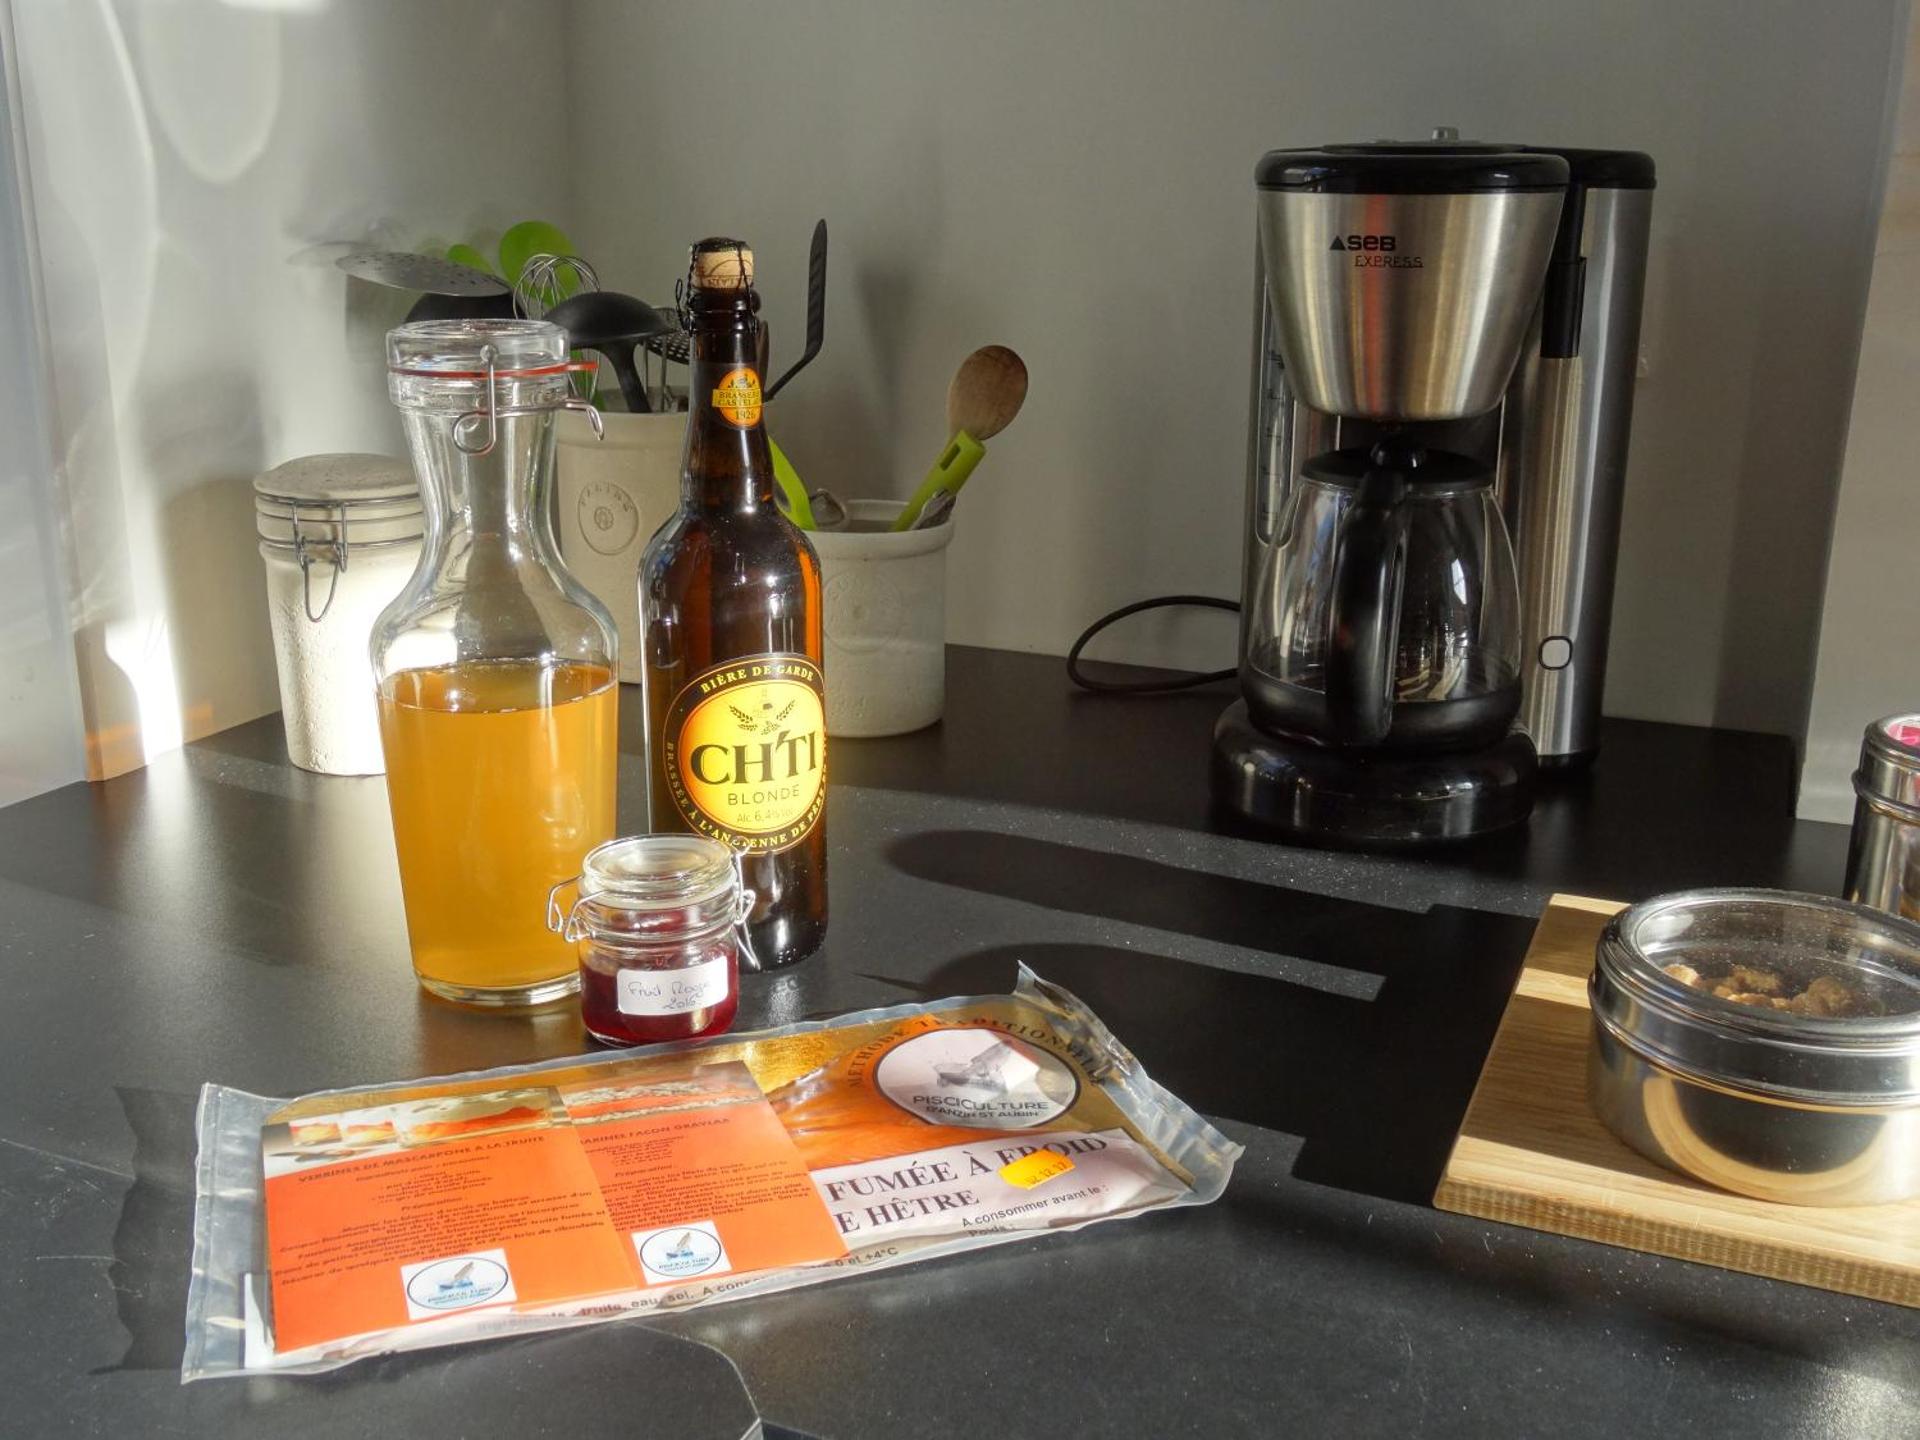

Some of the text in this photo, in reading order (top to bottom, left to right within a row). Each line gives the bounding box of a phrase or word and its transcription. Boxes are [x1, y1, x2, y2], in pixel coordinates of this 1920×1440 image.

[1354, 255, 1424, 269] EXPRESS
[700, 665, 814, 694] BIÈRE DE GARDE
[727, 784, 800, 806] BLONDE
[912, 1095, 1050, 1111] PISCICULTURE
[824, 1159, 960, 1202] FUMÉE
[966, 1150, 992, 1176] À
[867, 1188, 981, 1228] HÊTRE
[974, 1199, 1049, 1225] consommer
[1051, 1190, 1087, 1204] avant
[1088, 1186, 1101, 1197] le
